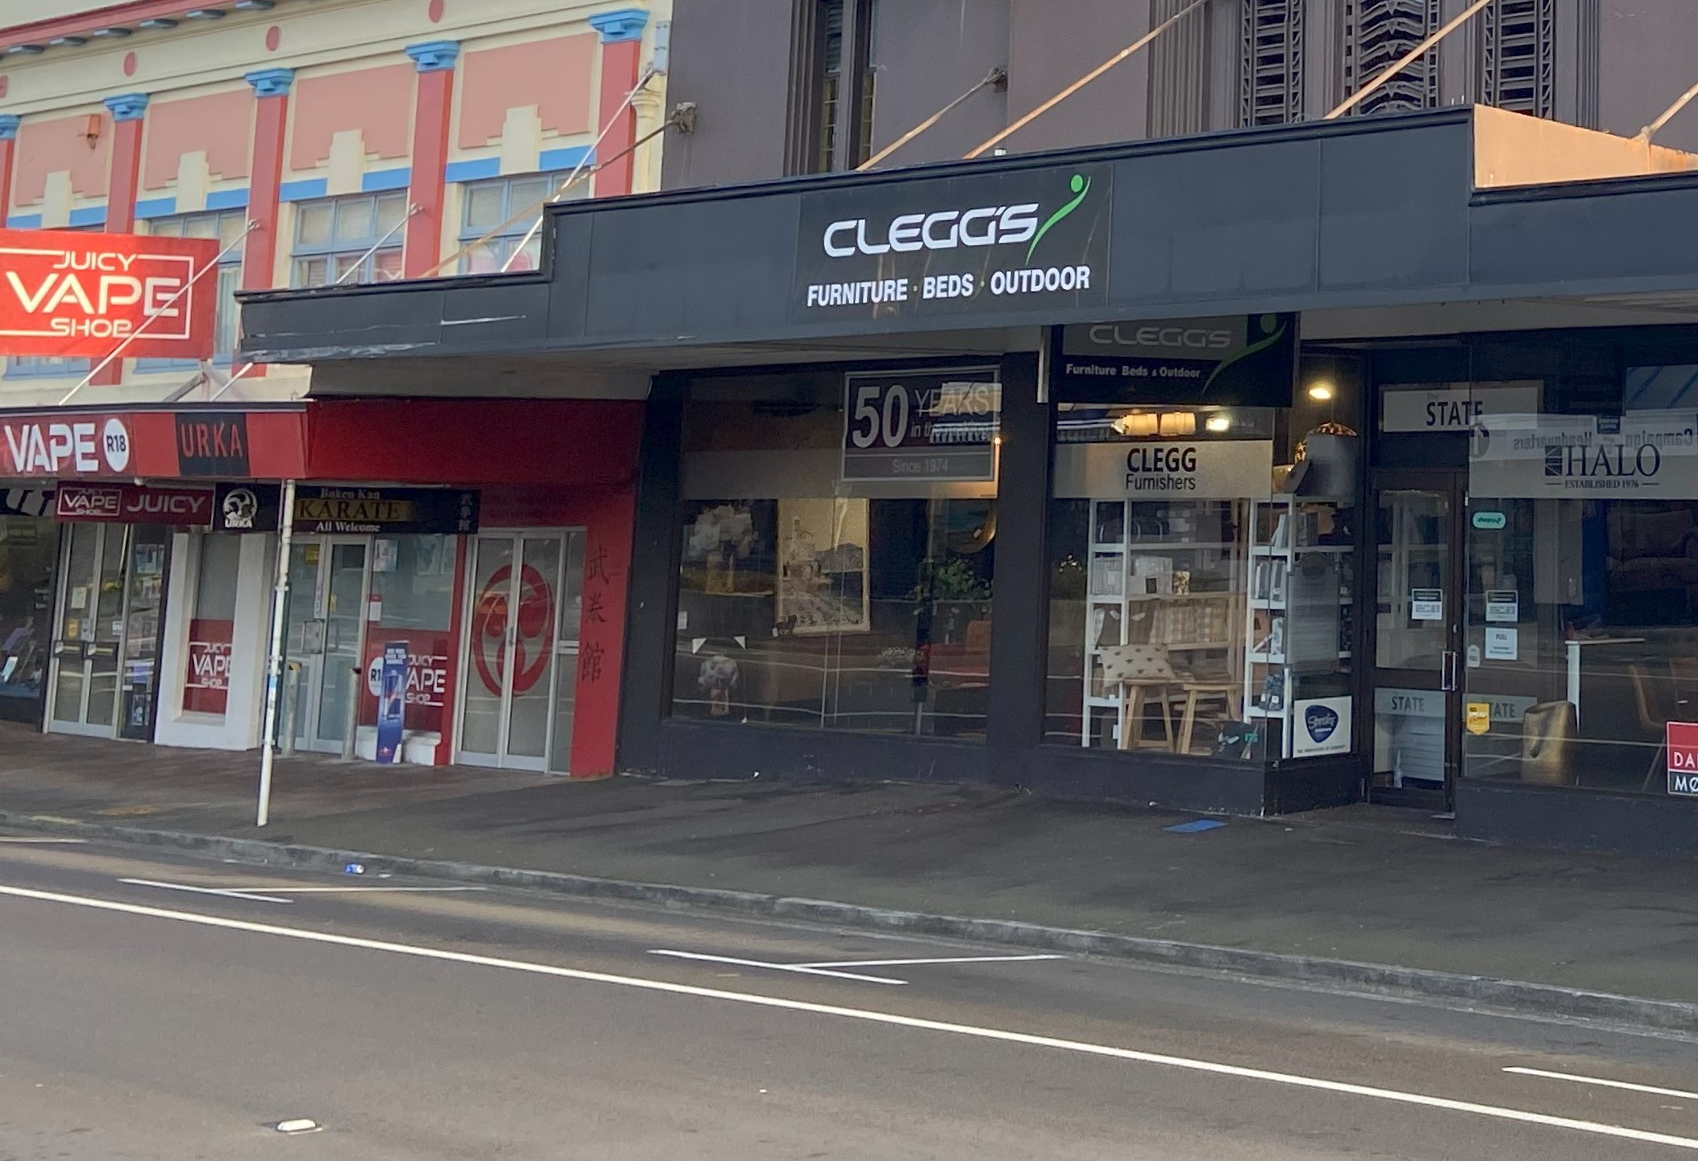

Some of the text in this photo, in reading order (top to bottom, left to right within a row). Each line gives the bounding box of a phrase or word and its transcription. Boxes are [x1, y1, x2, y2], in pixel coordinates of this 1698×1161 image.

[53, 251, 137, 271] JUICY
[6, 272, 181, 317] VAPE
[807, 265, 1091, 307] FURNITURE BEDS OUTDOOR
[50, 318, 132, 338] SHOP
[1066, 363, 1117, 376] Furniture
[1122, 365, 1148, 377] Beds
[1159, 366, 1201, 378] Outdoor
[852, 384, 909, 448] 50
[915, 387, 989, 416] YEARS
[911, 422, 921, 438] in
[4, 423, 127, 472] VAPE R18
[181, 422, 243, 458] URKA
[892, 458, 948, 473] Since 1974
[1127, 447, 1196, 472] CLEGG
[1566, 444, 1661, 477] HALO
[1125, 473, 1196, 490] Furnishers
[1565, 479, 1620, 488] ESTABLISHED
[64, 494, 117, 509] VAPE
[127, 494, 205, 513] JUICY
[300, 500, 401, 519] KARATE
[316, 521, 381, 533] All Welcome
[1391, 696, 1425, 712] STATE
